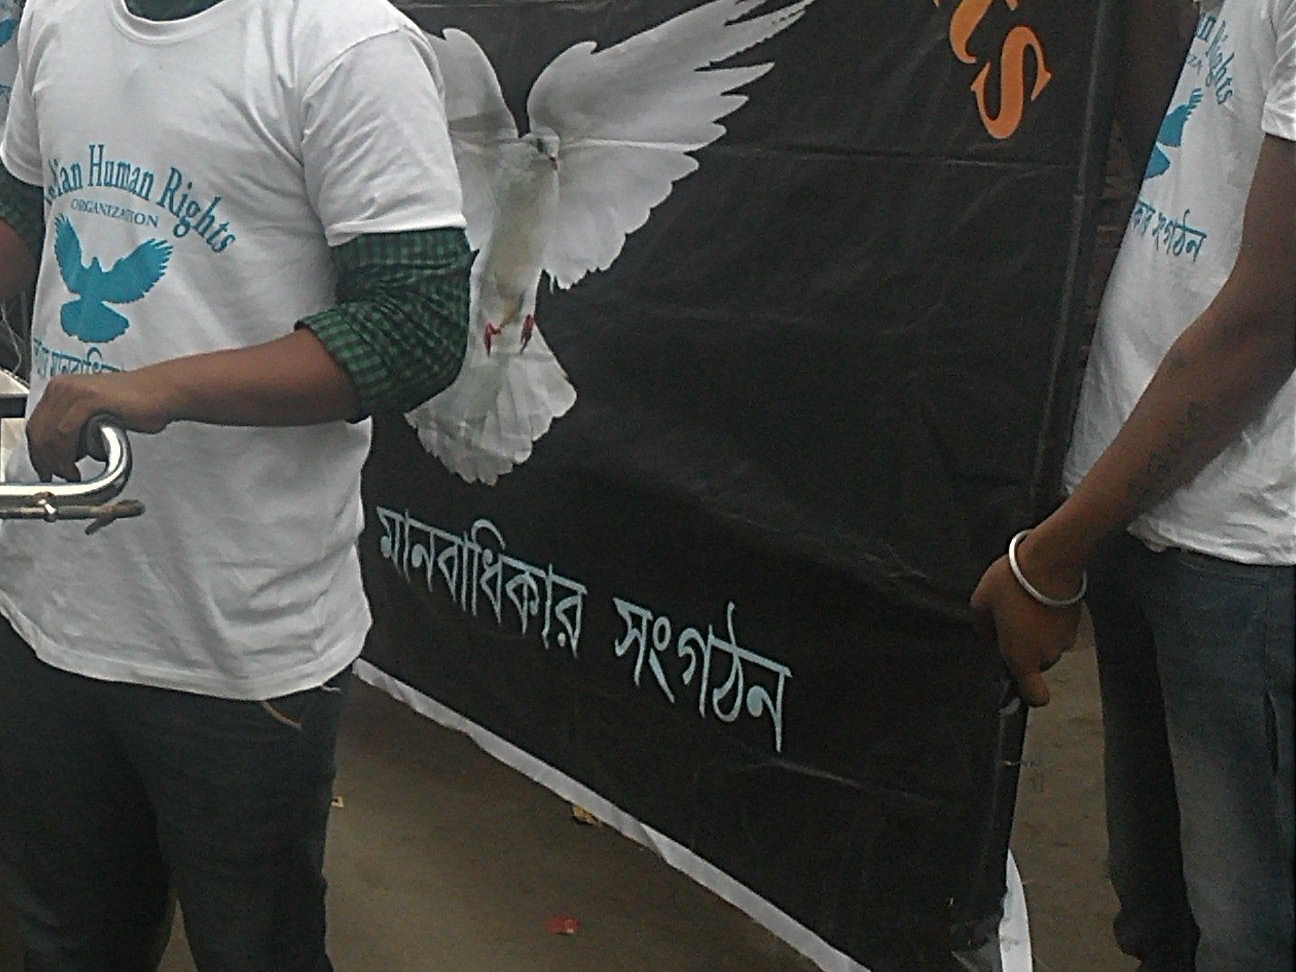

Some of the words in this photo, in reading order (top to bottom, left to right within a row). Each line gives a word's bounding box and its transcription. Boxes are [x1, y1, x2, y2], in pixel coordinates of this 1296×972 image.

[70, 198, 160, 228] ORGANIZATION
[88, 144, 154, 201] Human
[156, 166, 236, 254] Rights
[376, 506, 588, 660] মানবাধিকার
[613, 600, 793, 753] সংগঠন
